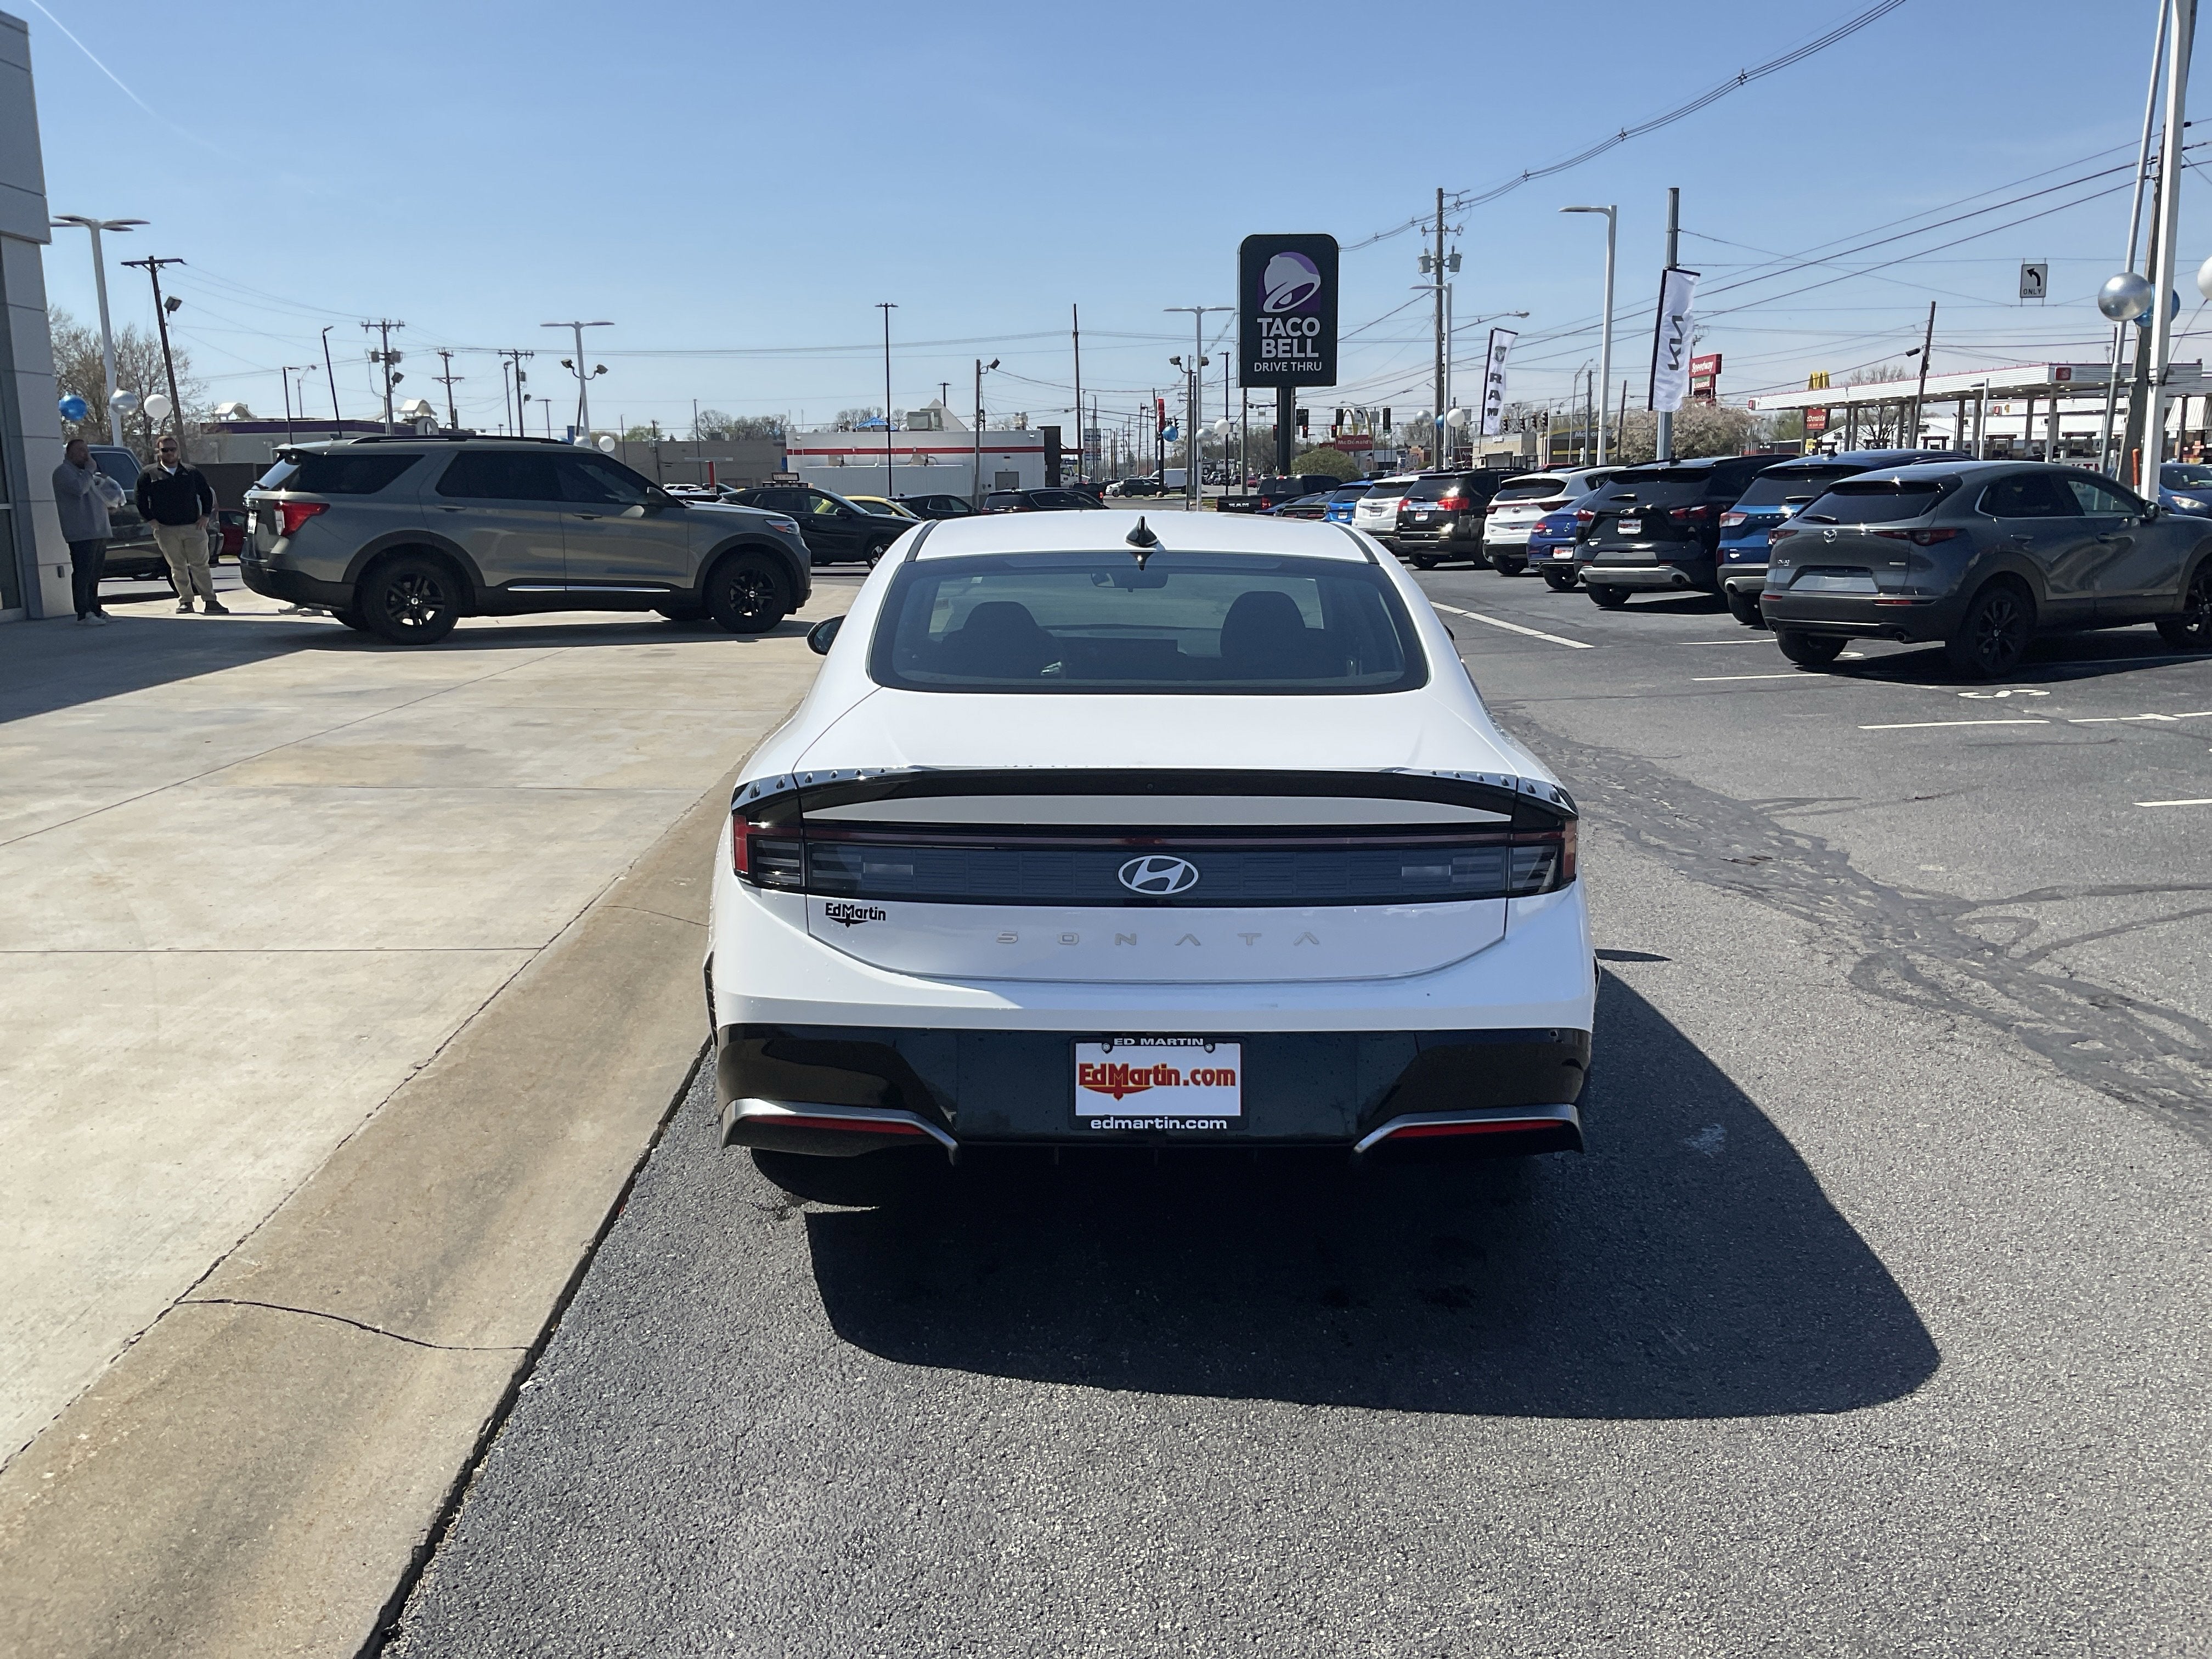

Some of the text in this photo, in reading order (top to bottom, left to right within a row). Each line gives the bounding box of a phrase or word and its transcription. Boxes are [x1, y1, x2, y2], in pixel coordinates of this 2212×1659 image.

[1257, 317, 1321, 337] TACO
[1262, 338, 1319, 358] BELL
[1254, 362, 1322, 372] DRIVE THRU
[1487, 373, 1502, 416] RAM
[825, 902, 886, 923] EdMartin
[996, 931, 1319, 946] SONATA
[1079, 1063, 1236, 1087] EdMartin.com
[1091, 1116, 1227, 1130] edmartin.com
